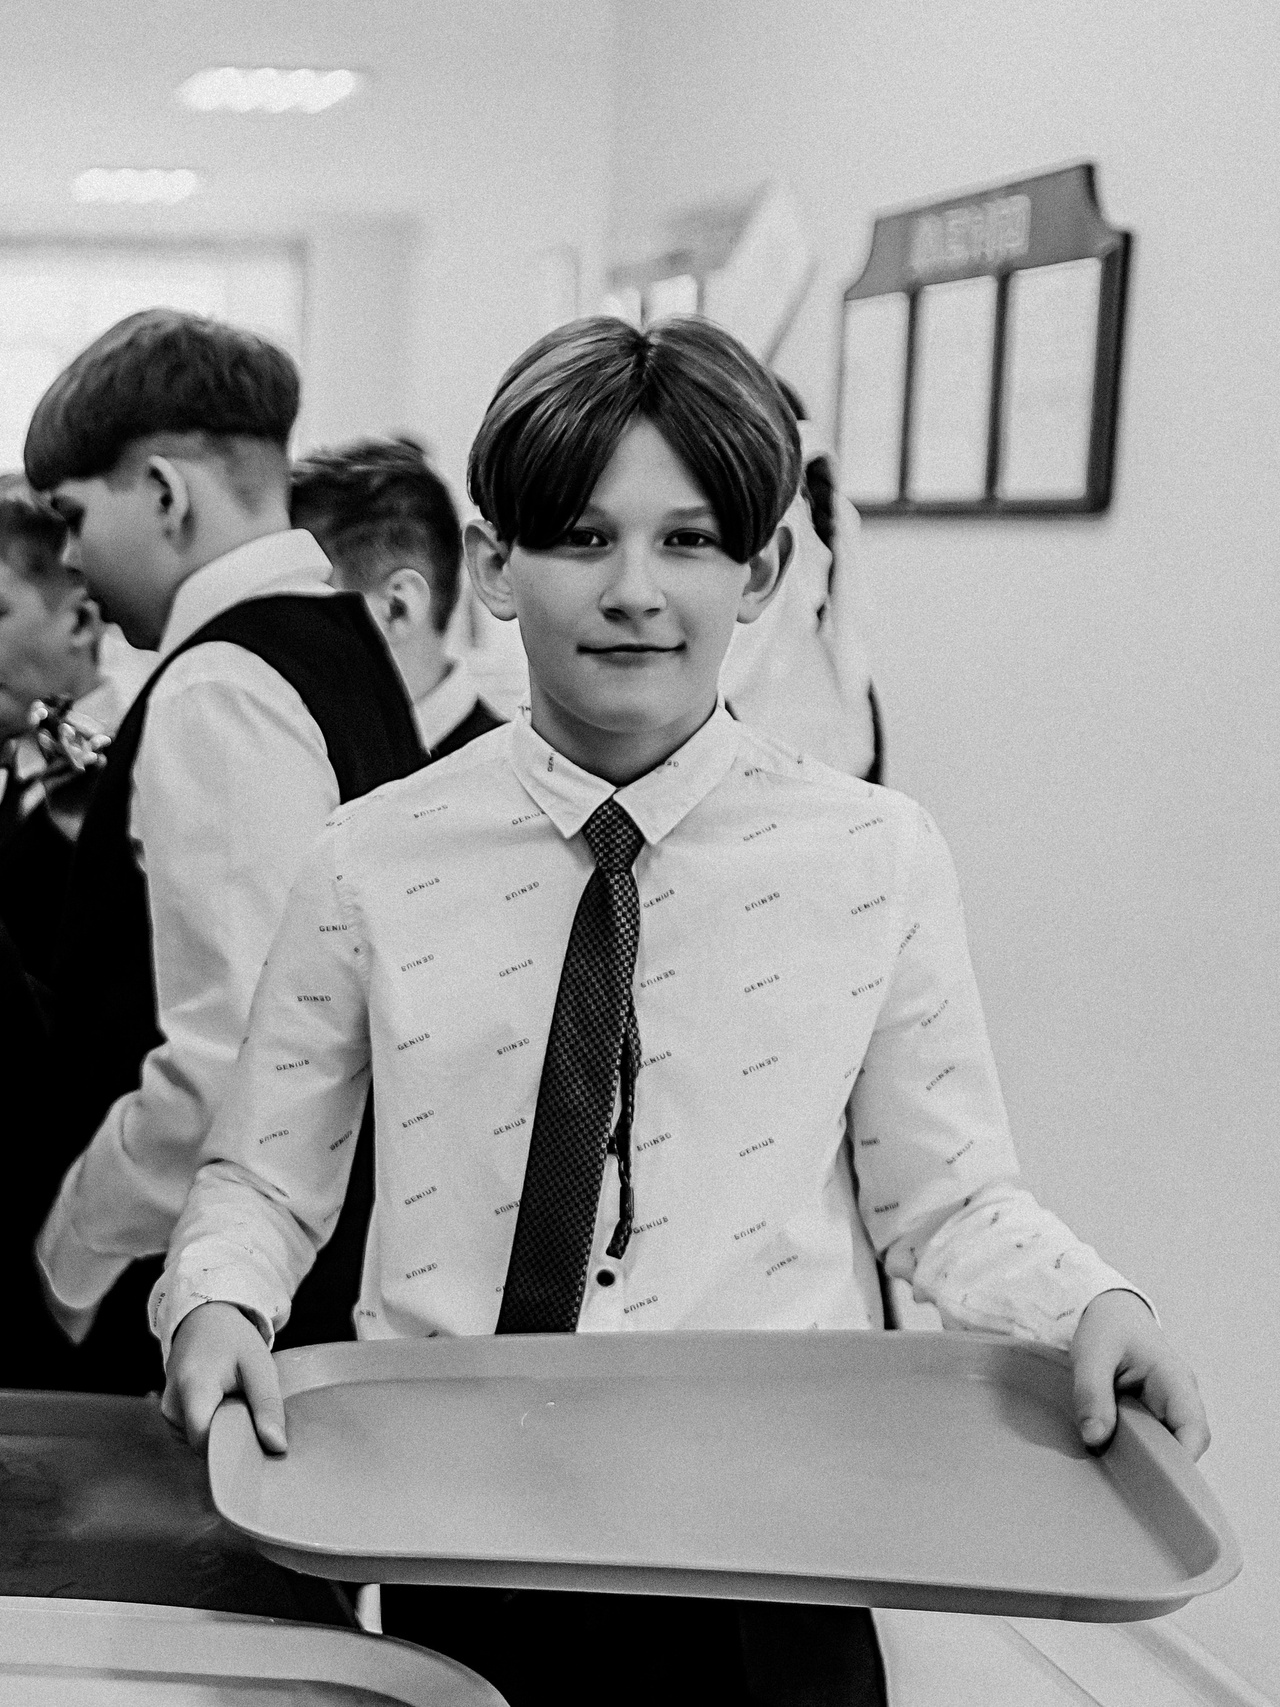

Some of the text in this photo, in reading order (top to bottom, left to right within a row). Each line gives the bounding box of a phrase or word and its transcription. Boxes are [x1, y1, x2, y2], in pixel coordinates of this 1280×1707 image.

[406, 876, 441, 896] GENIUS
[504, 881, 540, 902] GENIUS
[642, 888, 676, 909] GENIUS
[743, 891, 781, 913] GENIUS
[849, 894, 887, 916] GENIUS
[318, 924, 349, 934] GENIU
[400, 953, 435, 973] GENIUS
[498, 958, 534, 978] GENIUS
[639, 968, 676, 989] GENIUS
[743, 973, 781, 995] GENIUS
[296, 994, 332, 1004] GENIUS
[395, 1032, 431, 1052] GENIUS
[495, 1037, 530, 1057] GENIUS
[274, 1058, 311, 1073] GENIUS
[741, 1055, 779, 1077] GENIUS
[401, 1109, 435, 1130] GENIUS
[492, 1117, 527, 1137] GENIUS
[635, 1131, 673, 1153] GENIUS
[738, 1136, 775, 1158] GENIUS
[404, 1185, 438, 1207] GENIUS
[493, 1200, 520, 1217] ENIUS
[632, 1215, 669, 1236] GENIUS
[732, 1220, 767, 1241] GENIUS
[404, 1262, 438, 1281] GENIUS
[765, 1254, 799, 1277] GENIUS
[622, 1294, 659, 1316] GENIUS
